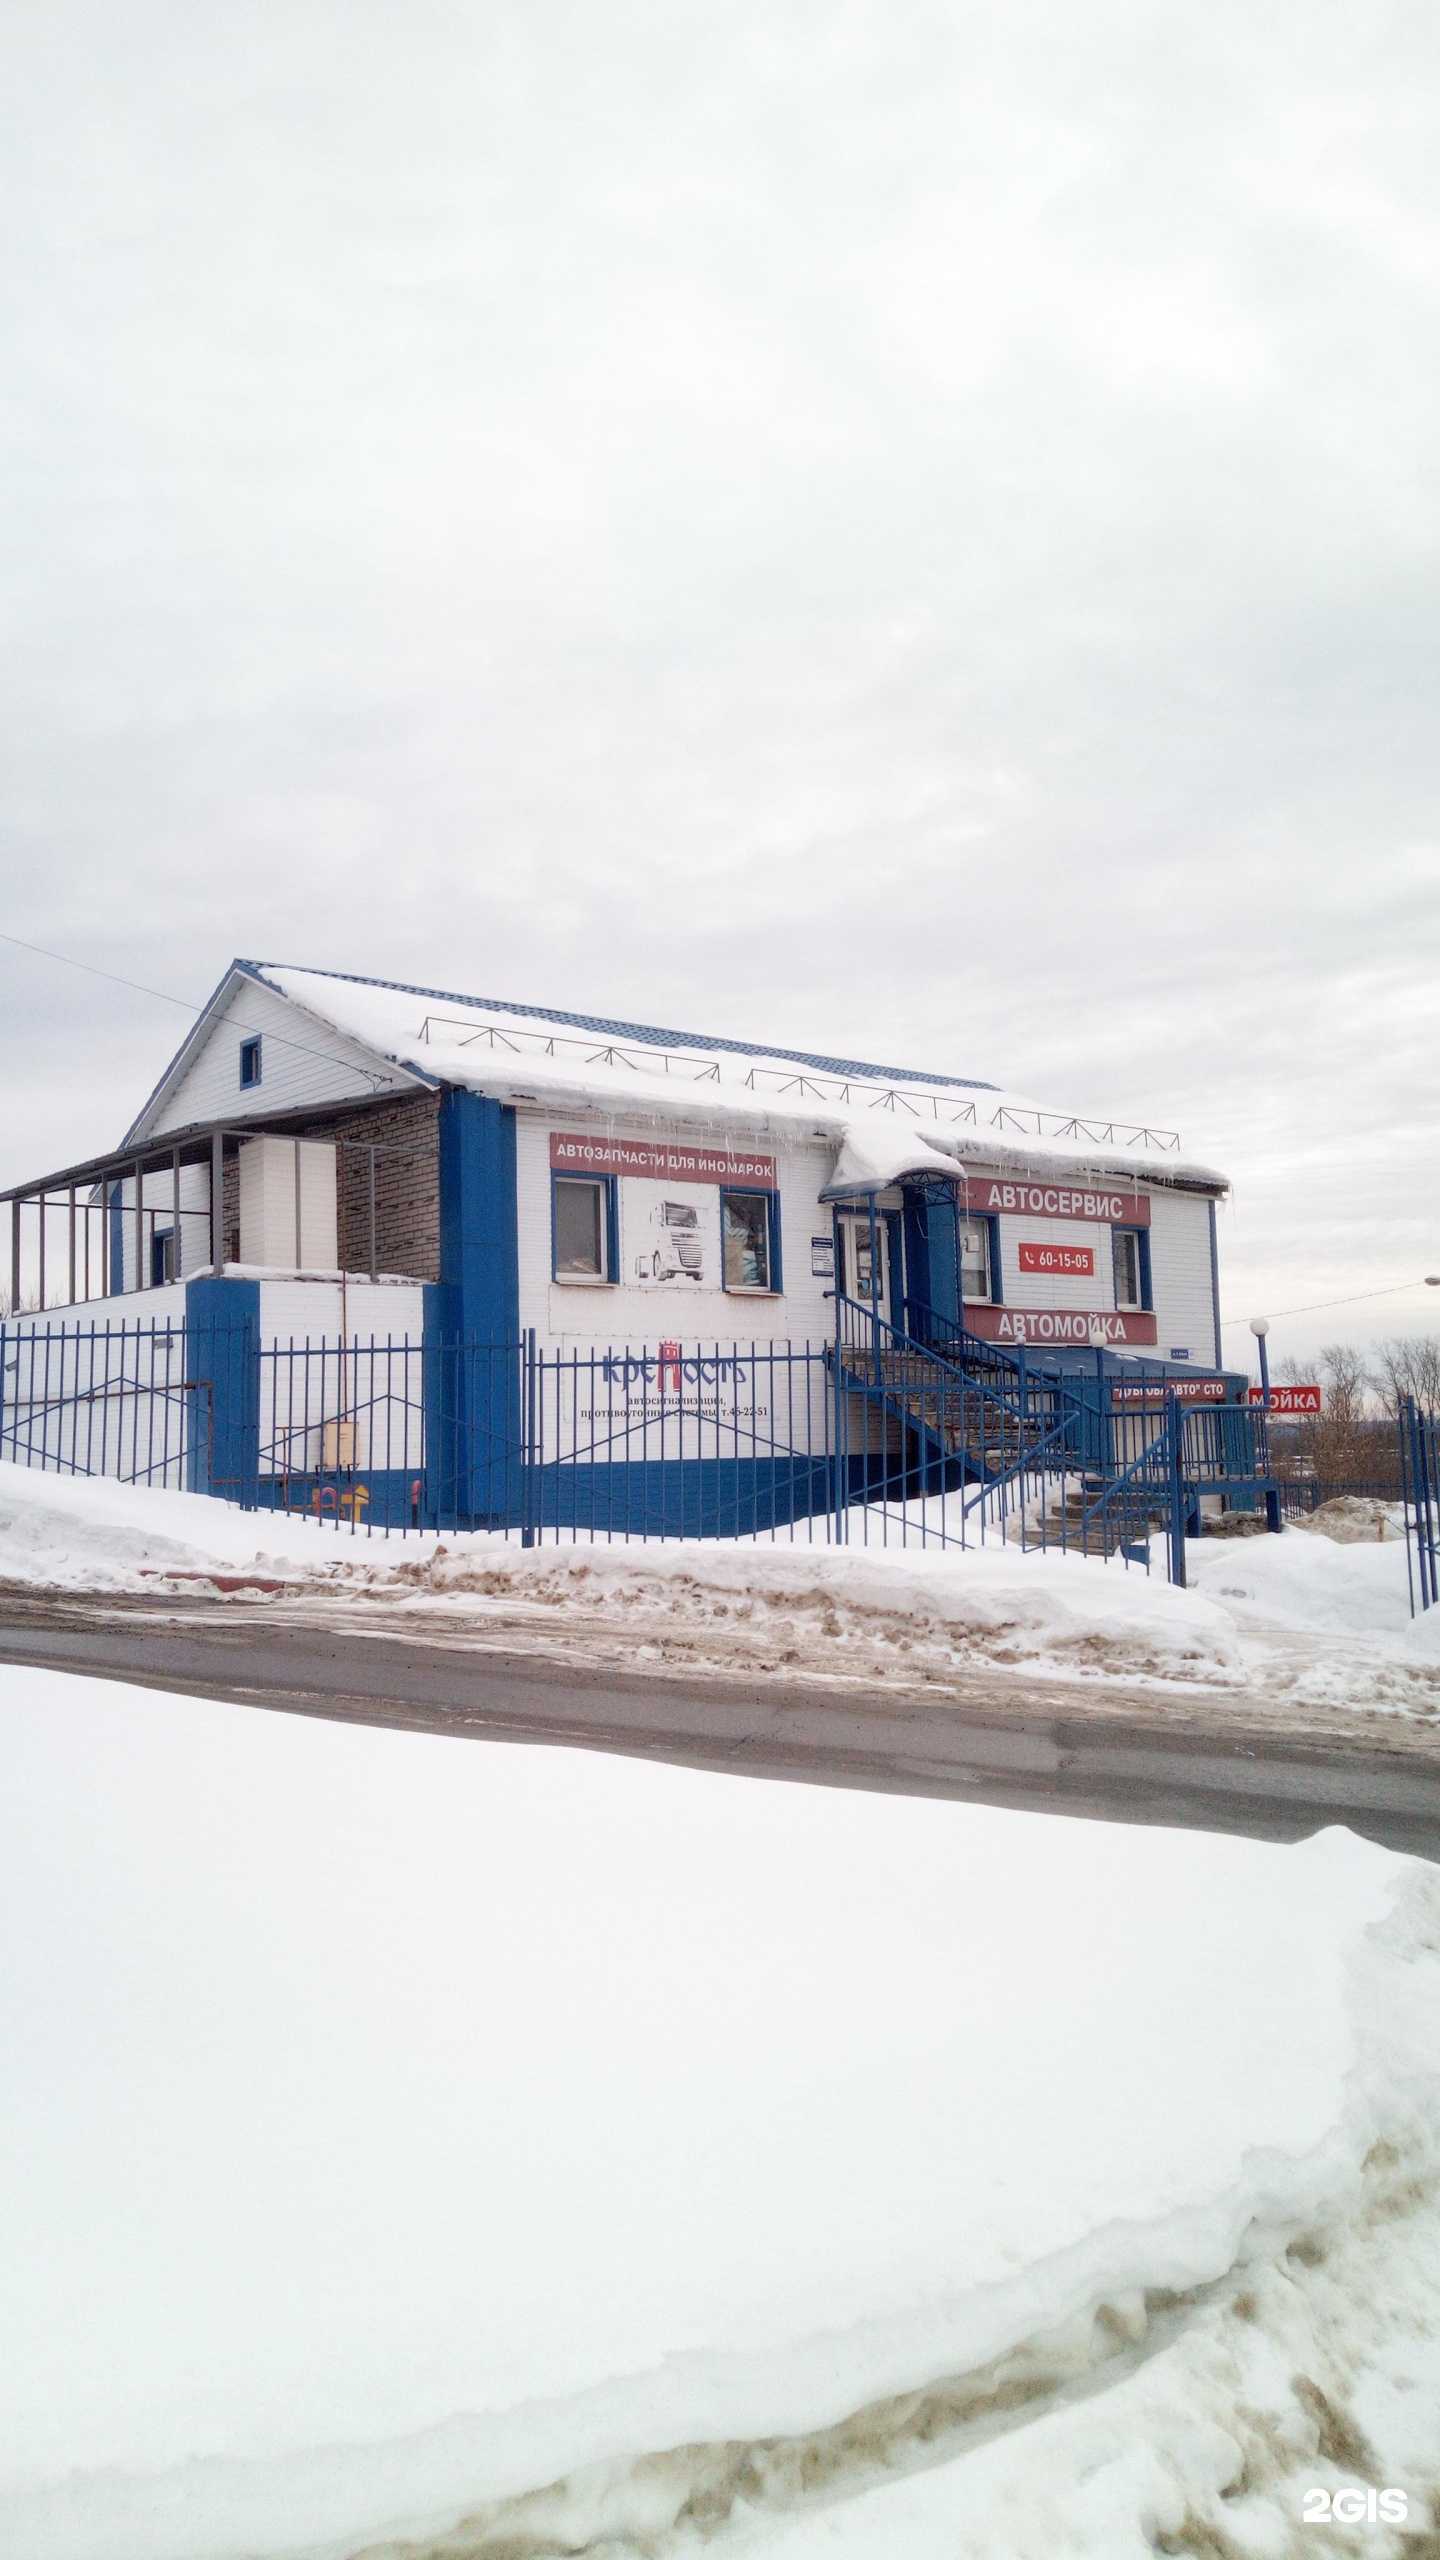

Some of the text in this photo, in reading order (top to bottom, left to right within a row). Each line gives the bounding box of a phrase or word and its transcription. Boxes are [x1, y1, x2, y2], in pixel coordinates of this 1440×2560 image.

[557, 1143, 772, 1177] АВТОЗАПЧАСТИ ДЛЯ ИНОМАРОК
[988, 1184, 1123, 1219] АВТОСЕРВИС
[1039, 1251, 1089, 1269] 60-15-05
[998, 1313, 1127, 1340] АВТОМОЙКА
[1204, 1383, 1224, 1395] СТО
[1251, 1389, 1318, 1409] МОЙКА
